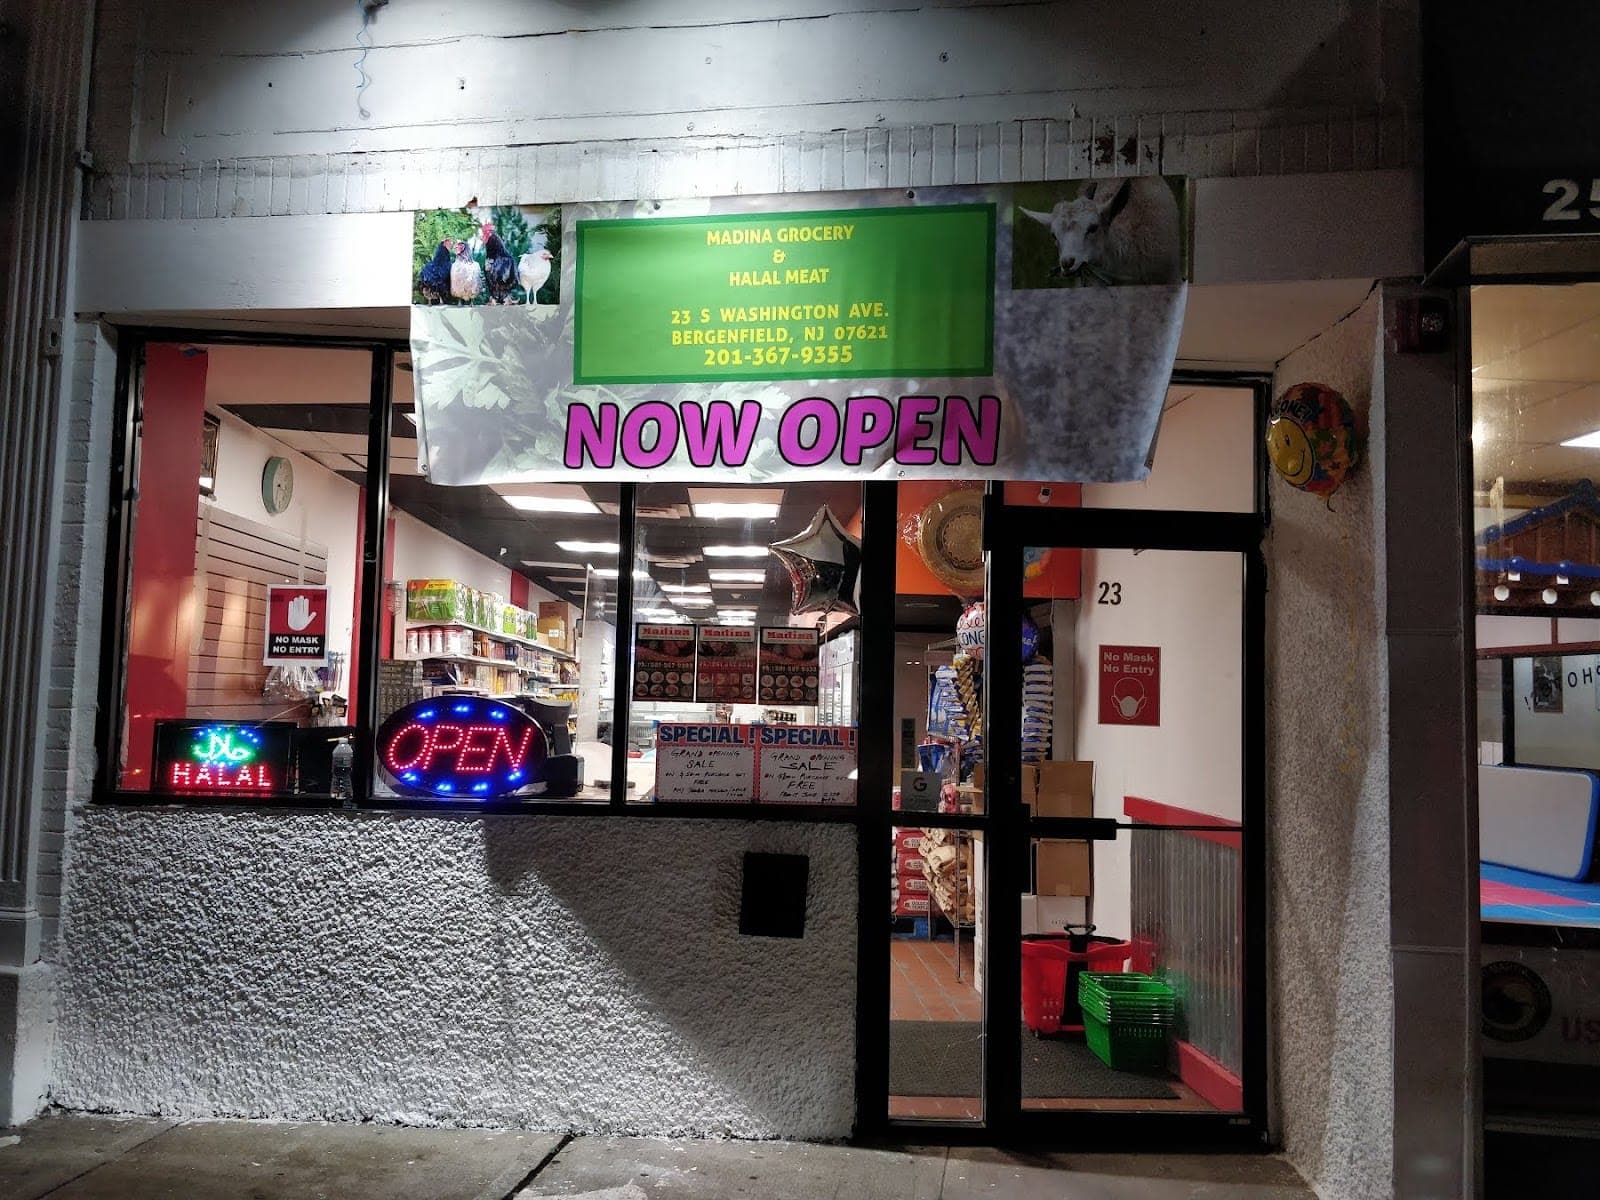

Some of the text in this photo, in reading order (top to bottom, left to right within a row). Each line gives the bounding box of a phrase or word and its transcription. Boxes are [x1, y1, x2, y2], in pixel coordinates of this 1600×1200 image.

[707, 225, 855, 246] MADINA GROCERY
[773, 249, 787, 264] &
[729, 268, 830, 287] HALAL MEAT
[671, 302, 889, 325] 23 S WASHINGTON AVE.
[671, 325, 889, 345] BERGENFIELD, NJ 07621
[703, 345, 853, 366] 201-367-9355
[563, 396, 1002, 470] NOW OPEN
[1098, 581, 1122, 606] 23
[275, 636, 319, 644] NO MASK
[288, 646, 320, 654] ENTRY
[1103, 652, 1155, 662] No Mask
[1103, 664, 1155, 676] No Entry
[659, 725, 744, 744] SPECIAL
[760, 727, 844, 746] SPECIAL
[387, 723, 534, 773] OPEN
[770, 752, 801, 761] GRAND
[686, 760, 715, 769] SALE
[779, 761, 838, 771] SALE
[171, 762, 273, 787] HALAL
[787, 780, 816, 790] FREE
